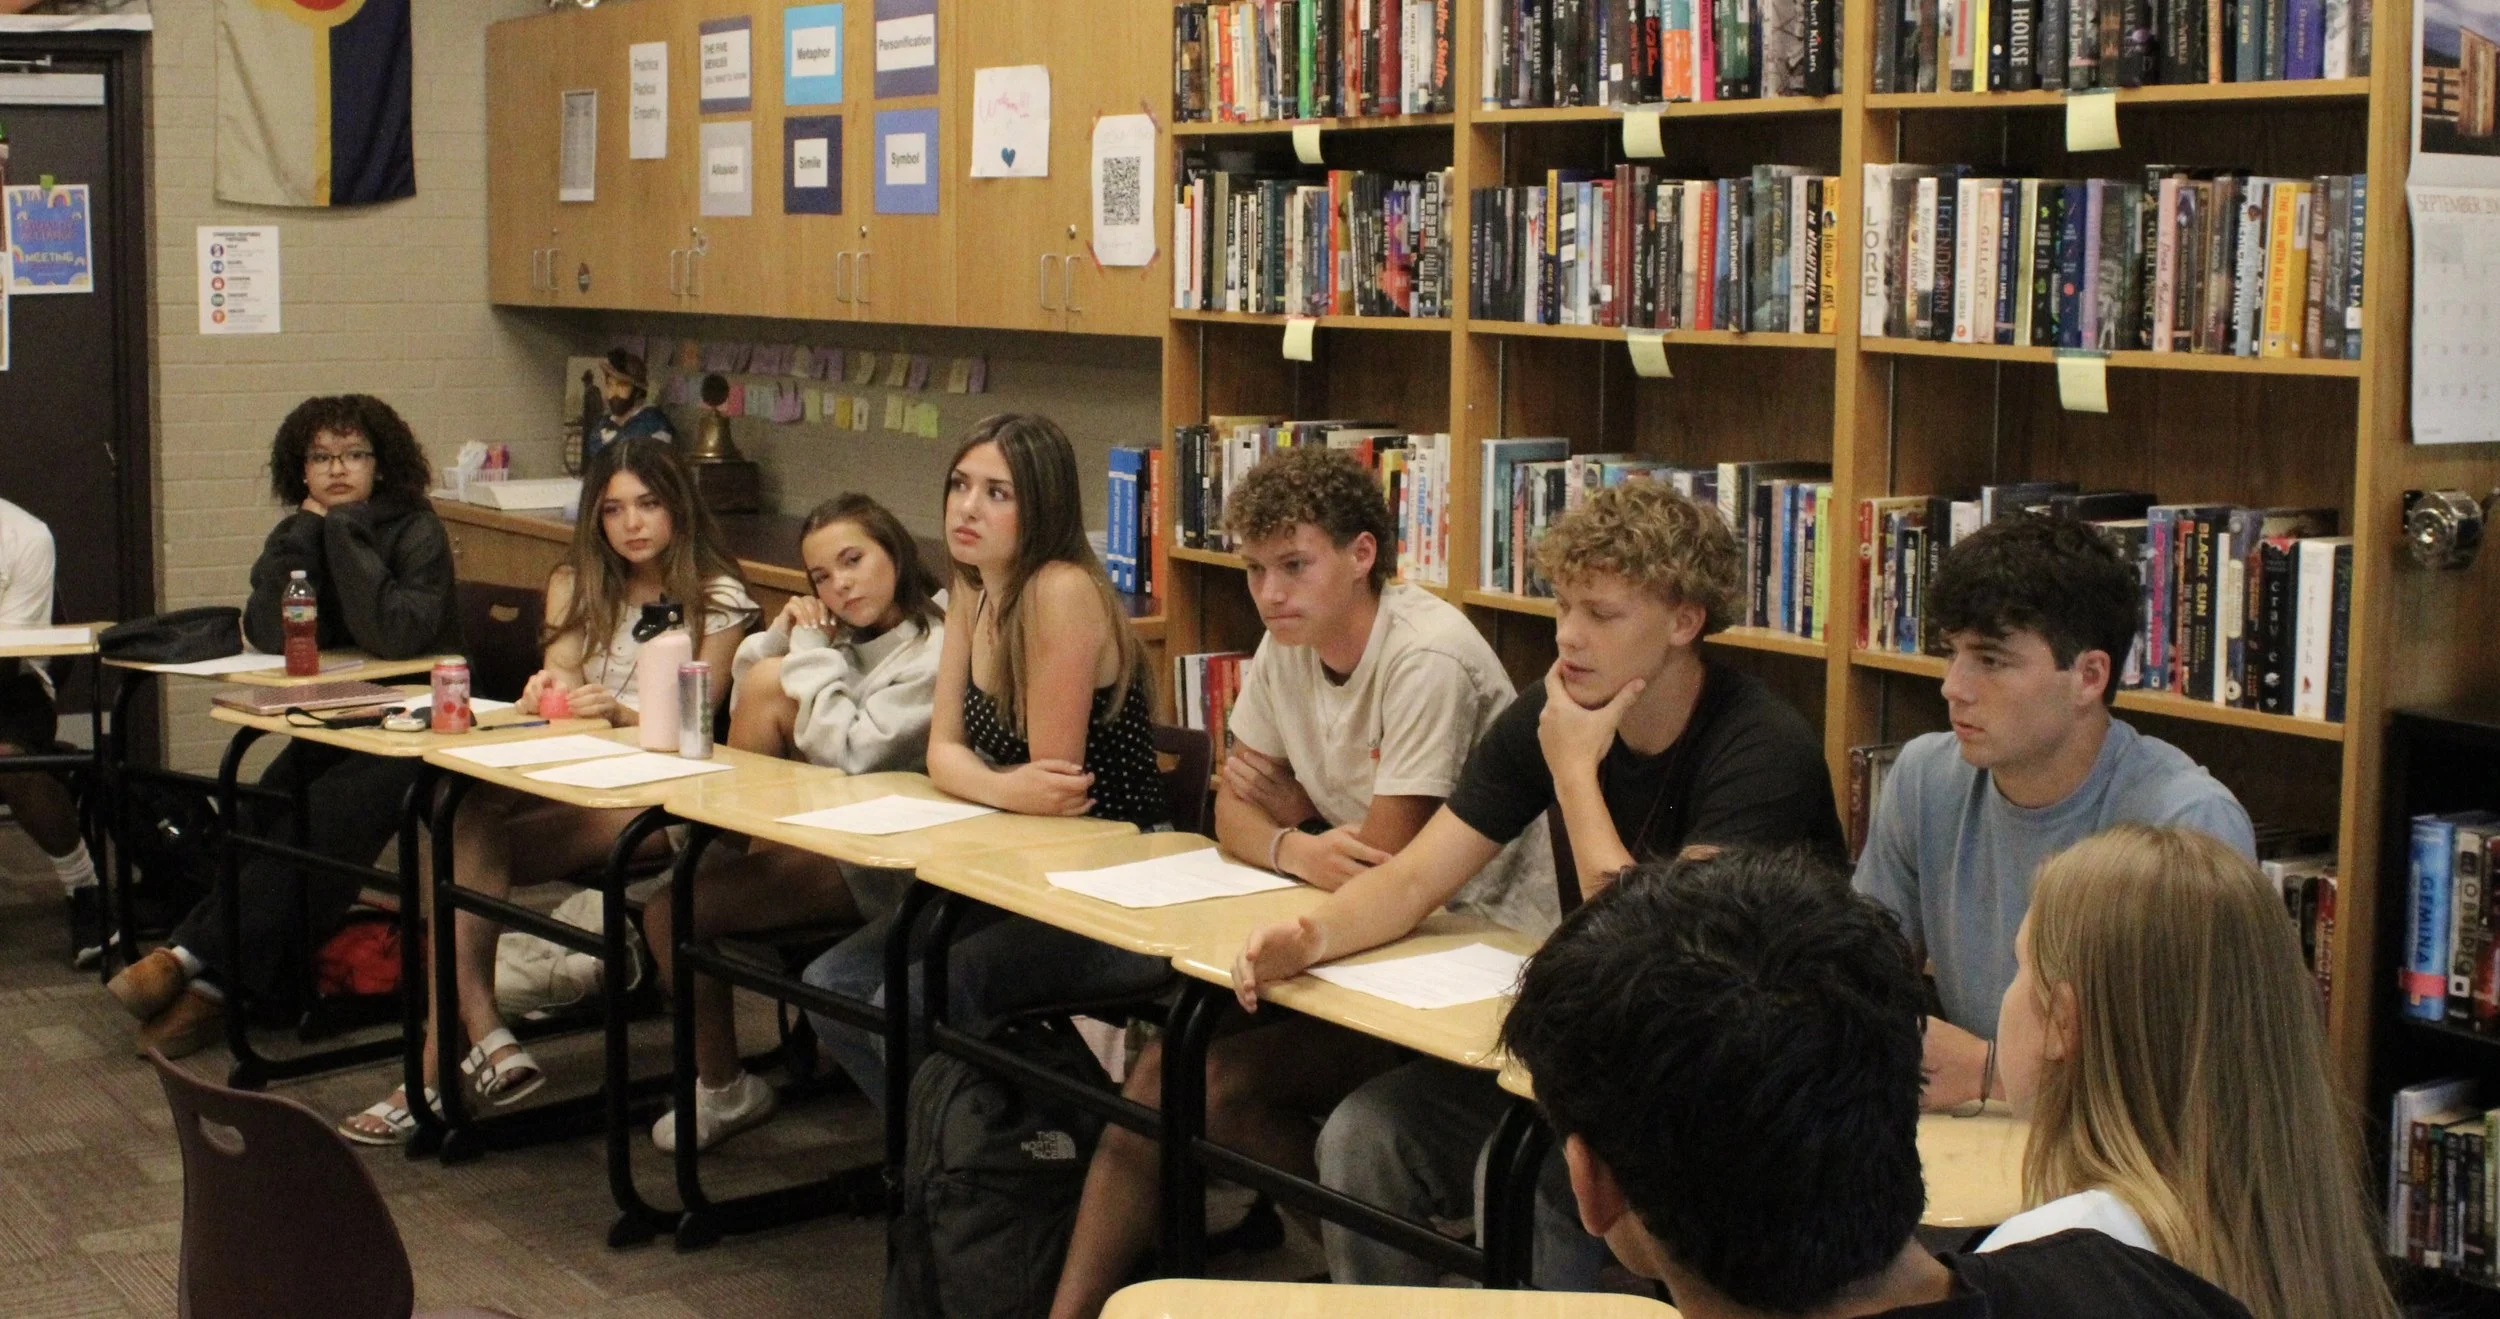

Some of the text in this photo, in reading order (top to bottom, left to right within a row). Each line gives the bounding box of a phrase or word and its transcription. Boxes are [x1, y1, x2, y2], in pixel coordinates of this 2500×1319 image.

[1436, 0, 1449, 34] elter
[2298, 8, 2308, 59] Dreamer
[796, 47, 831, 62] Metaphor
[878, 35, 932, 51] Personification
[1533, 6, 1542, 74] ONE WAS LOST
[2010, 8, 2030, 67] HOUSE
[634, 58, 659, 72] Practice
[634, 82, 656, 96] Radical
[633, 106, 661, 121] Empathy
[711, 163, 738, 177] Allusion
[799, 156, 821, 170] Simile
[891, 151, 919, 169] Symbol
[2416, 194, 2481, 214] SEPTEMBER
[2314, 214, 2325, 235] AND
[24, 250, 74, 264] MEETING
[1701, 234, 1710, 283] CHINATOWN
[1730, 231, 1739, 281] EVERYTHING
[1805, 210, 1818, 303] IN NIGHTFALL
[1864, 206, 1880, 297] LORE
[1934, 196, 1953, 314] LEGENDBORN
[1978, 225, 1991, 299] GALLANT
[2160, 241, 2171, 272] Dear
[2212, 235, 2221, 269] BLOOD
[2269, 195, 2290, 333] THE GIRL WITH ALL THE GIFTS
[2350, 232, 2365, 279] ELIZA
[1471, 256, 1479, 284] TWIN
[1821, 234, 1836, 310] HOLLOW FIRES
[2232, 208, 2248, 331] AMERICAN STREET
[2000, 282, 2008, 300] LIVE
[2309, 276, 2322, 302] LOOK
[2308, 307, 2321, 334] BACK
[1151, 459, 1160, 537] Food For Today
[2195, 523, 2210, 617] BLACK SUN
[2182, 627, 2192, 662] RUNNER
[2417, 876, 2435, 965] GEMINA
[2455, 883, 2480, 975] OBSIDIO
[1020, 1141, 1057, 1151] NORTH
[1036, 1131, 1056, 1141] THE
[1033, 1151, 1058, 1160] FACE
